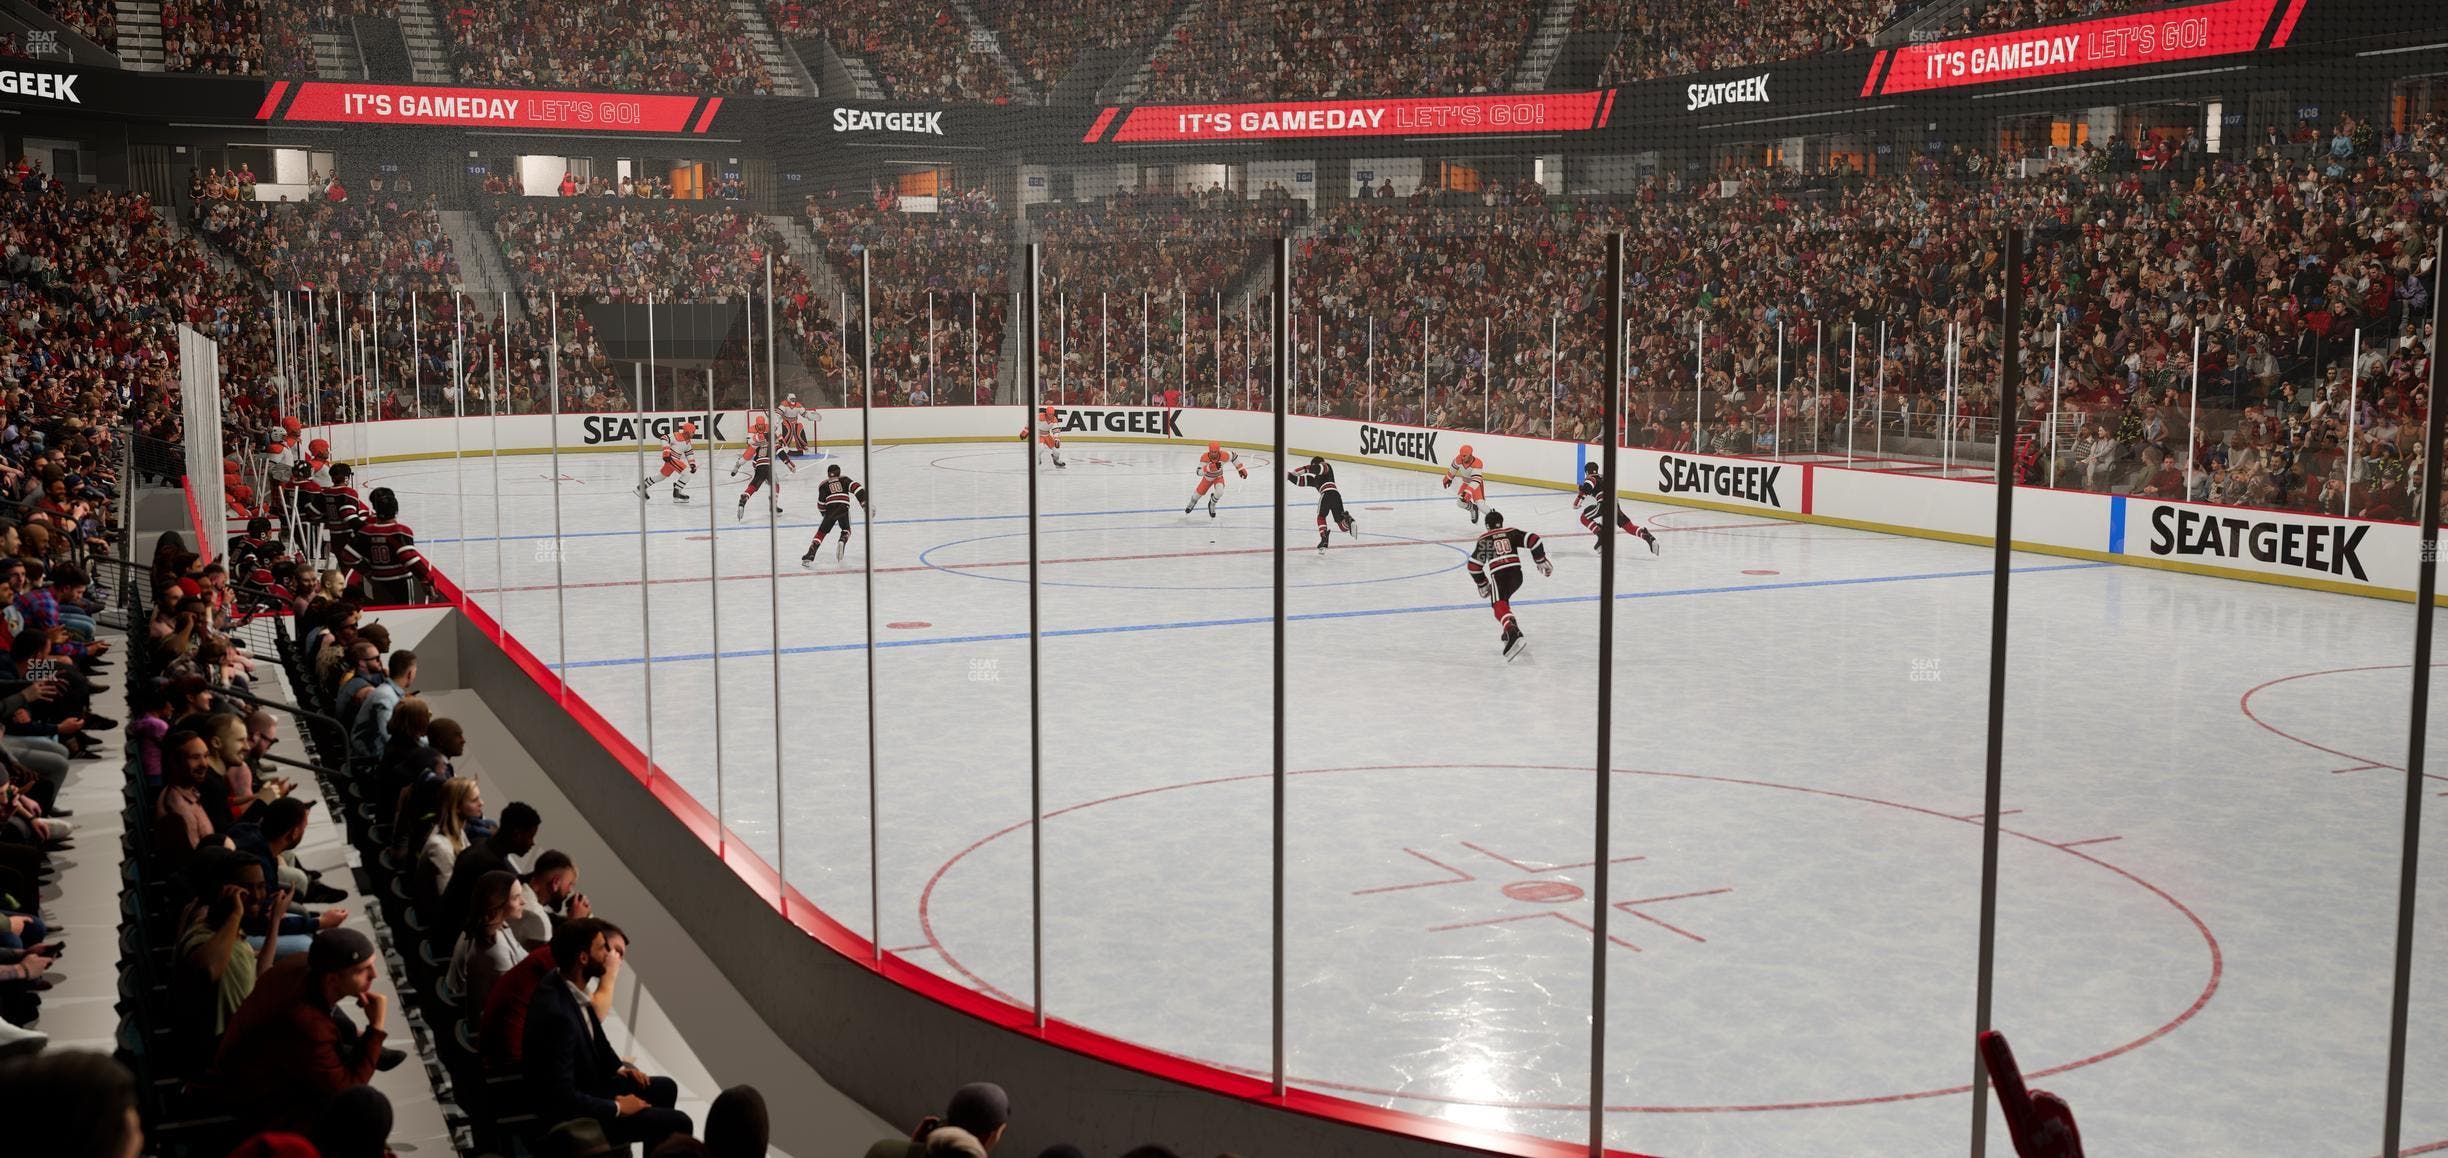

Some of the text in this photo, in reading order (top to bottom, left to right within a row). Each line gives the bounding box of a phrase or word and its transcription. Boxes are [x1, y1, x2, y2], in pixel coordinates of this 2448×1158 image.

[1927, 18, 2208, 80] IT'S GAMEDAY LET'S GO!
[0, 70, 81, 104] GEEK
[1687, 73, 1770, 111] SEATGEEK
[345, 93, 640, 124] IT'S GAMEDAY LET'S GO!
[833, 108, 944, 135] SEATGEEK
[1179, 103, 1544, 133] IT'S GAMEDAY LET'S GO!
[1039, 407, 1184, 437] EATGEEK
[1360, 424, 1438, 465] SEATGEEK
[1659, 455, 1781, 508] SEATGEEK
[2150, 505, 2371, 582] SEATGEEK
